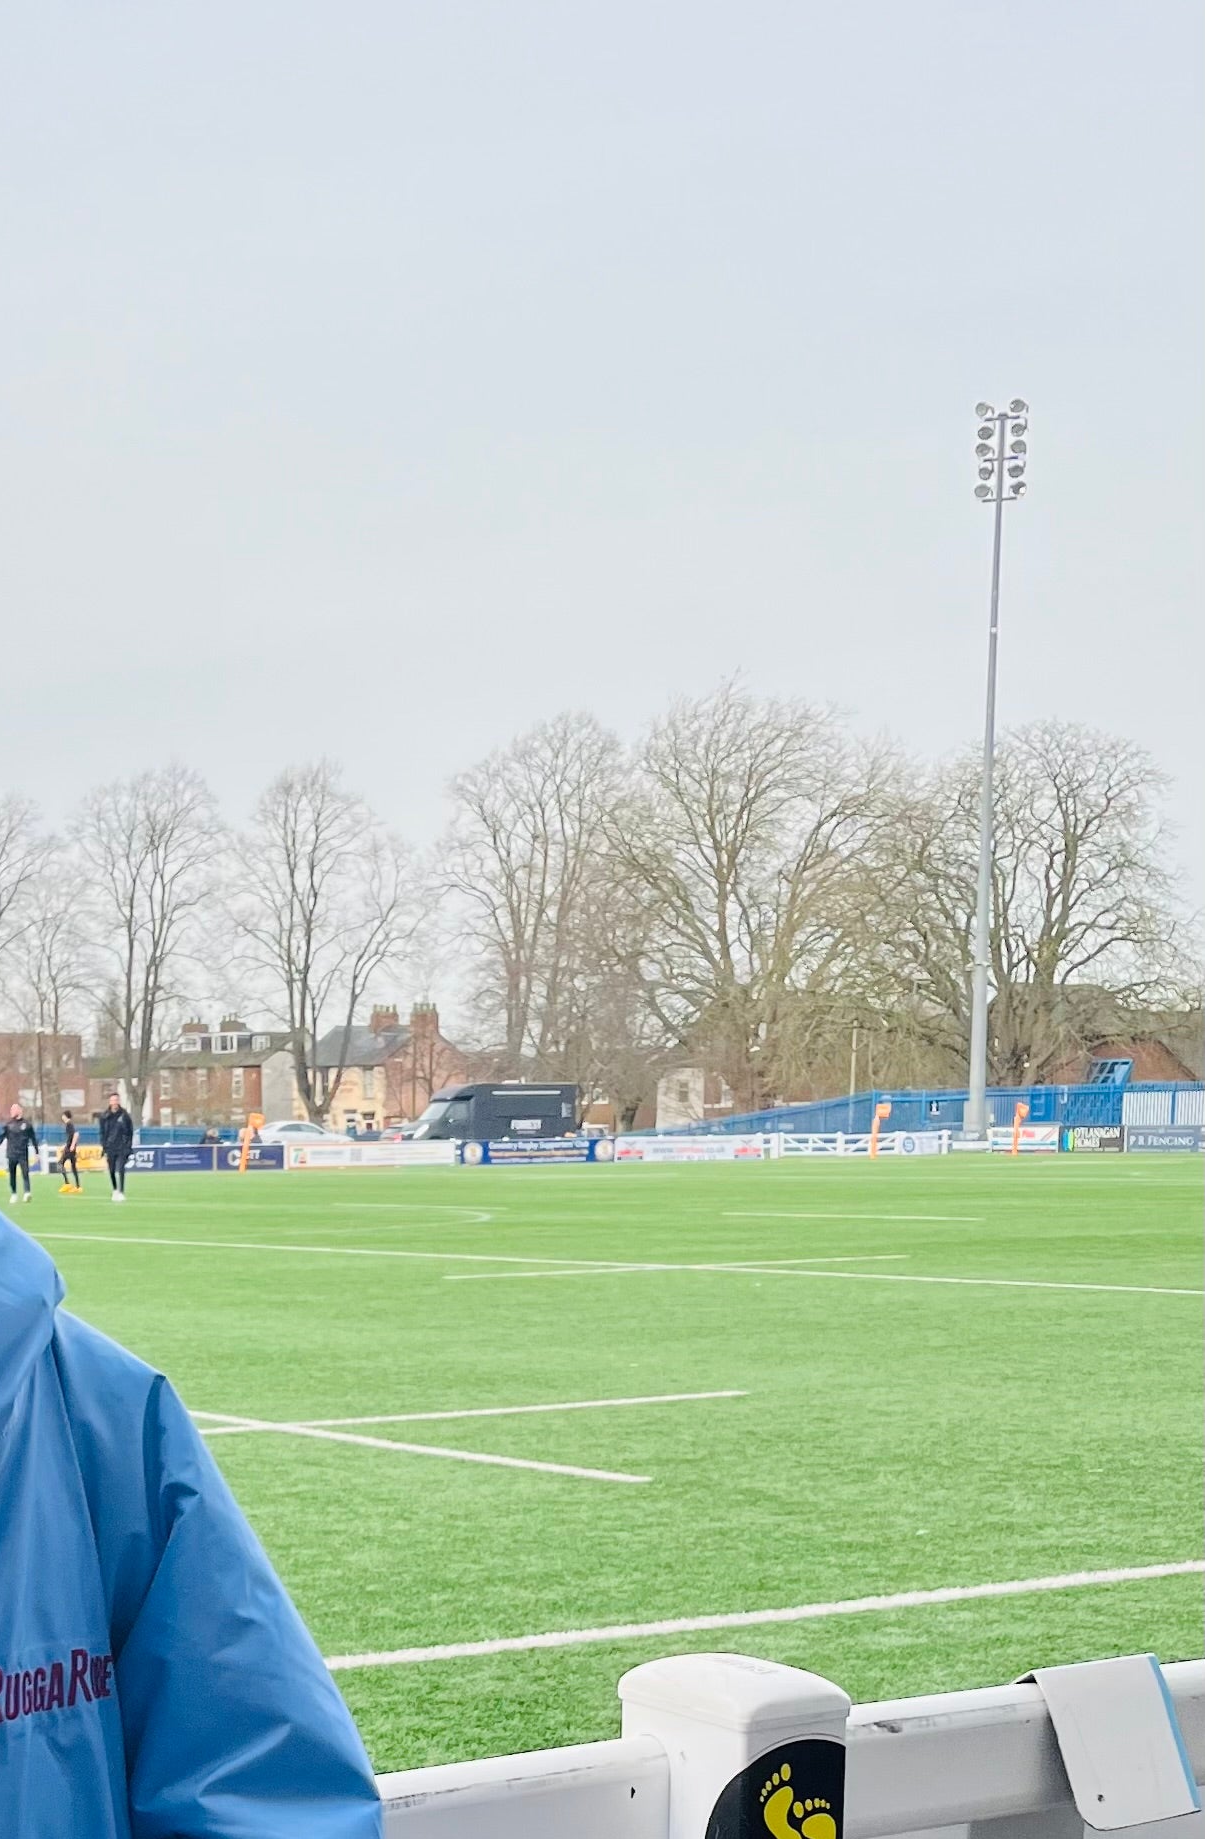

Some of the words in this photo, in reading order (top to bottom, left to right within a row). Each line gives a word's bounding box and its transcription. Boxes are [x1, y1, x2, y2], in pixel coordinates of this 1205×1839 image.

[1129, 1135, 1137, 1146] P
[1138, 1135, 1146, 1146] R
[1147, 1134, 1195, 1147] FENCING
